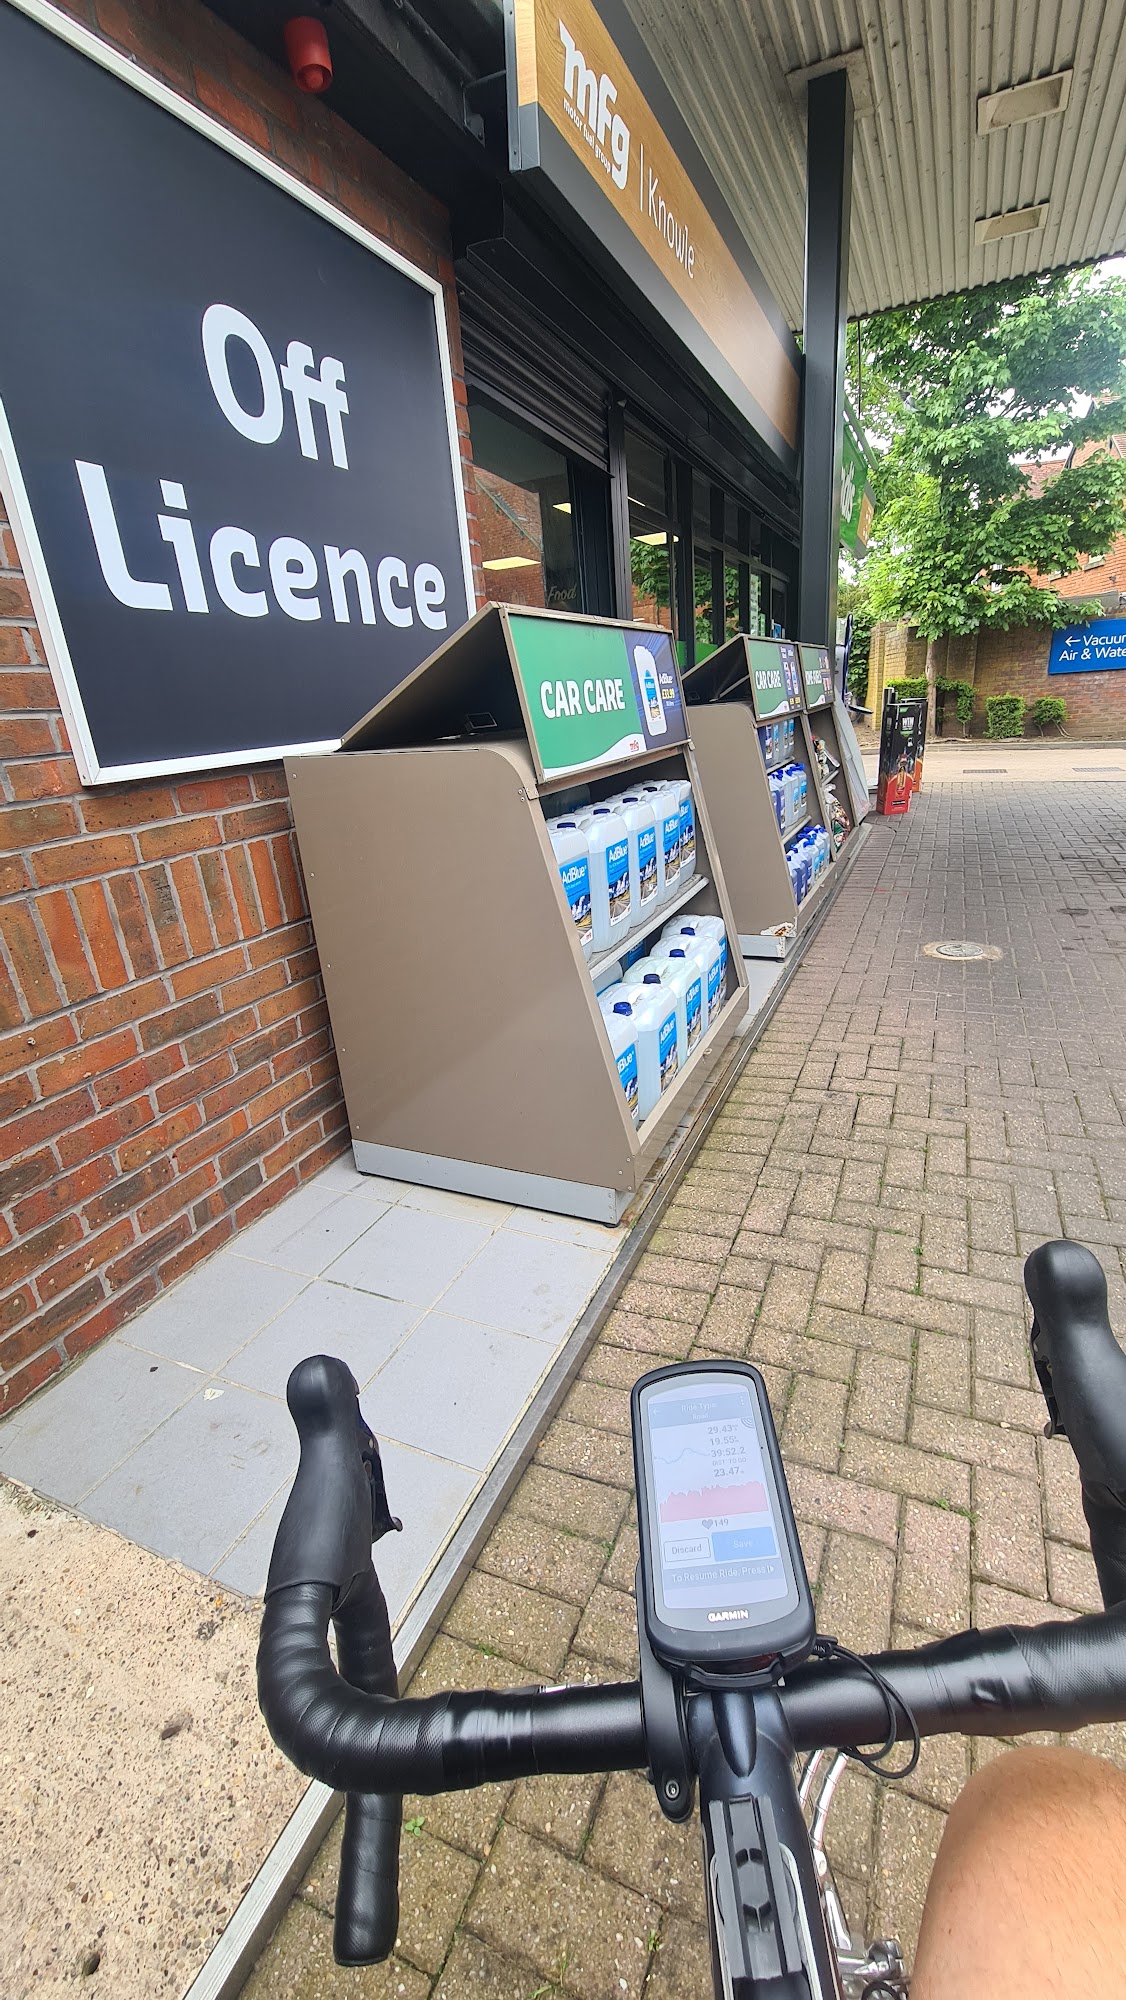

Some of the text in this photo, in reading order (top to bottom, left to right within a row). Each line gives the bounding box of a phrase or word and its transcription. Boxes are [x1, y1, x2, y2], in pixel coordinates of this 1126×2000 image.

[559, 19, 630, 190] mfg
[563, 98, 611, 174] motor fuel group
[648, 167, 695, 278] Knowle
[202, 303, 350, 470] Off
[75, 459, 448, 631] Licence
[548, 584, 577, 601] Food
[1058, 650, 1079, 661] Air
[1081, 648, 1092, 659] &
[755, 670, 782, 690] CAR CARE
[540, 678, 626, 719] CAR CARE
[902, 717, 915, 727] WIN
[665, 818, 679, 834] AdBlue
[639, 833, 655, 849] AdBlue
[608, 844, 628, 864] AdBlue
[562, 865, 586, 884] AdBlue
[687, 984, 700, 1005] AdBlue
[660, 1018, 675, 1044] AdBlue
[681, 1404, 697, 1412] Ride
[707, 1424, 732, 1435] 29.43
[710, 1436, 734, 1446] 19.55
[711, 1447, 746, 1458] 39:52.2
[714, 1466, 740, 1477] 23.47
[714, 1518, 729, 1527] 149
[671, 1544, 703, 1554] Discard
[733, 1540, 753, 1549] Save
[672, 1574, 683, 1583] To
[682, 1570, 717, 1581] Resume
[742, 1565, 766, 1576] Press
[707, 1609, 749, 1622] GARMIN
